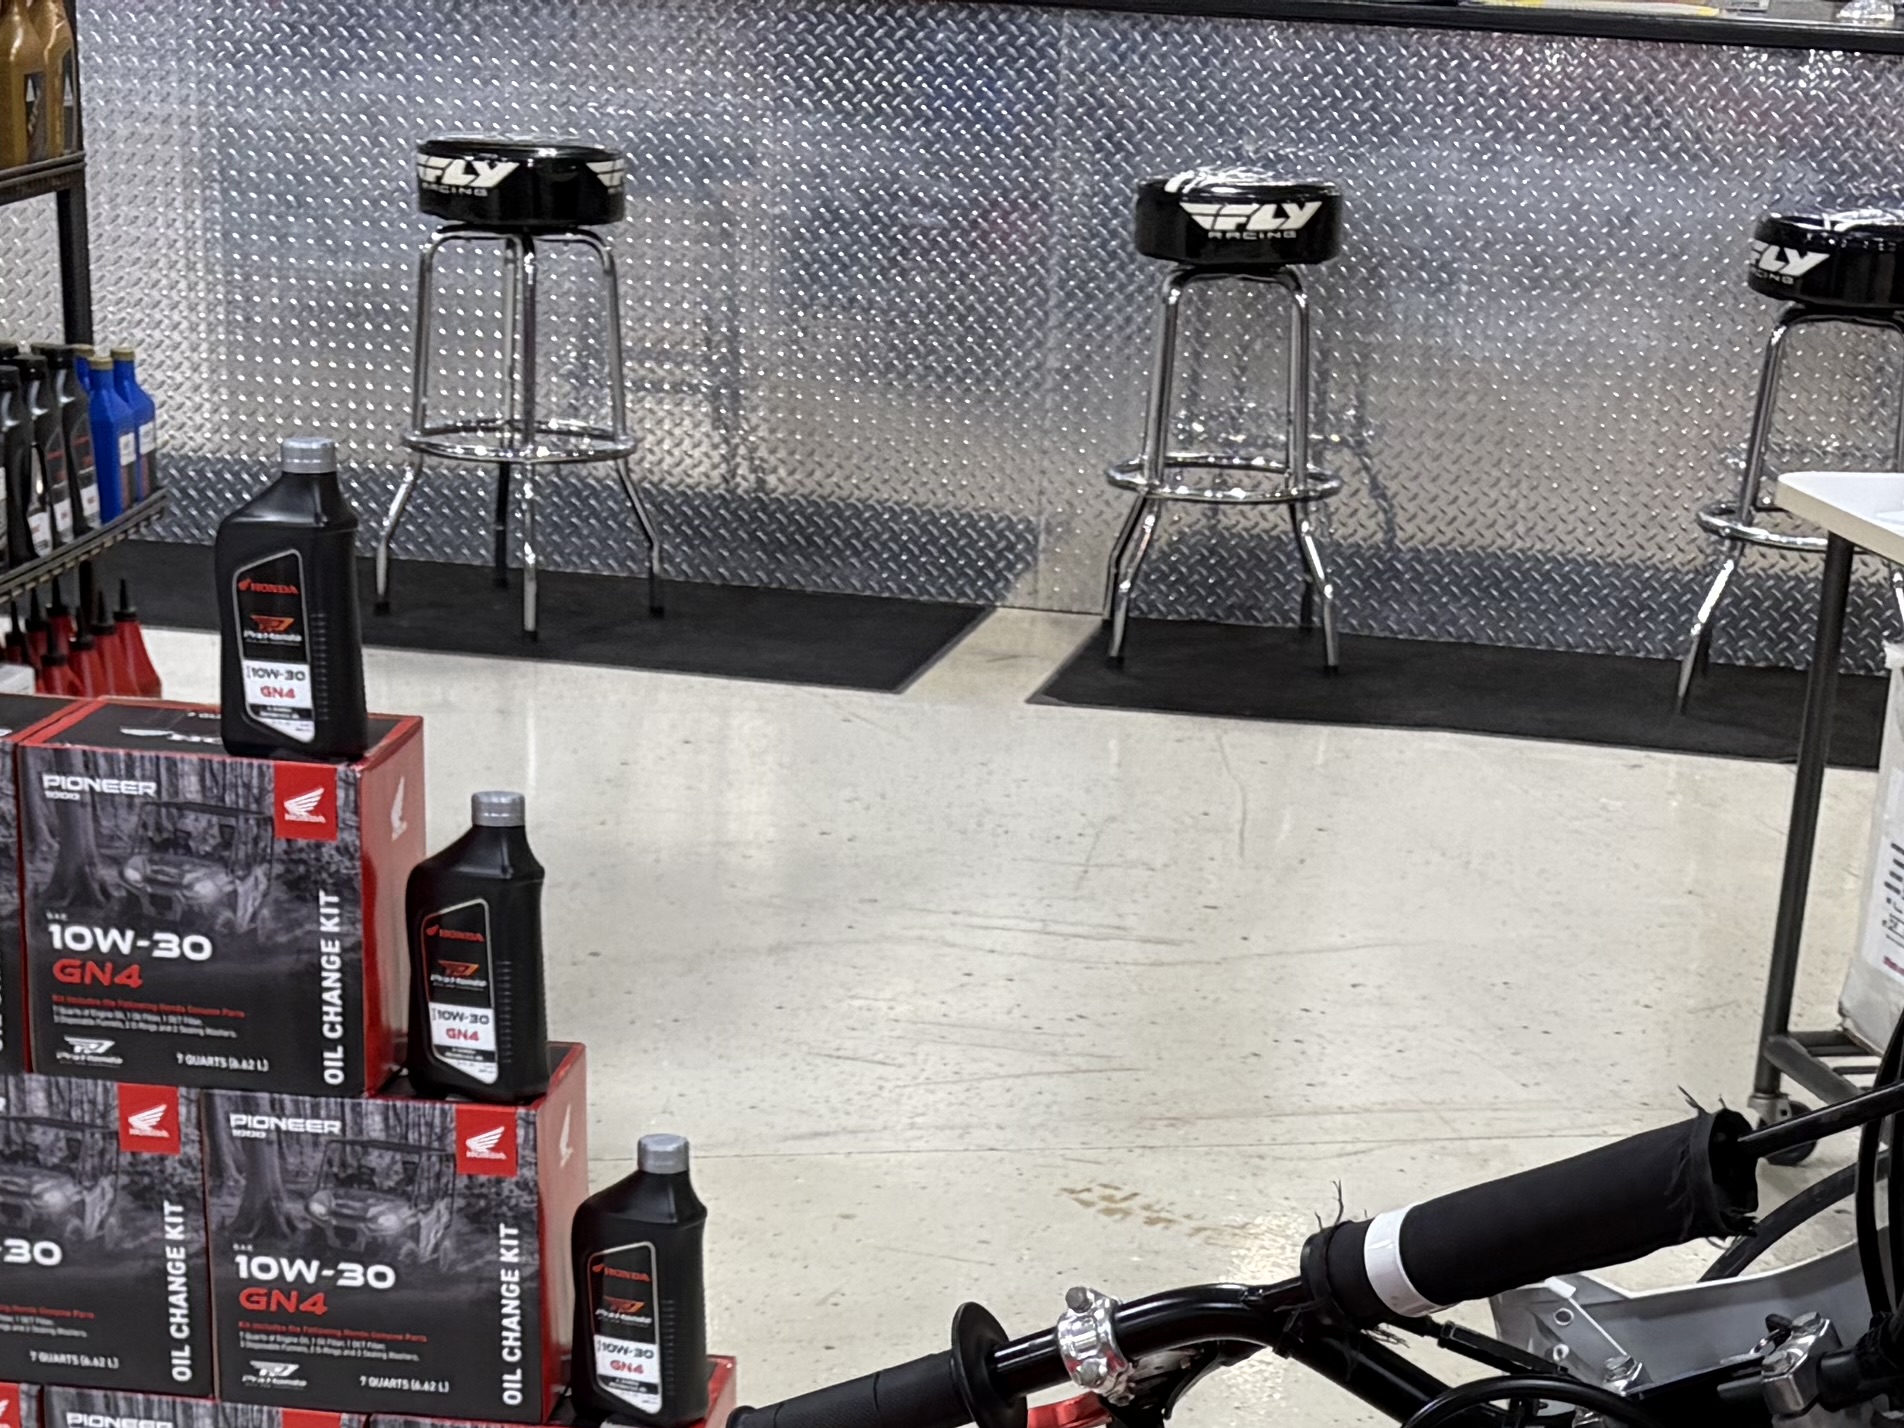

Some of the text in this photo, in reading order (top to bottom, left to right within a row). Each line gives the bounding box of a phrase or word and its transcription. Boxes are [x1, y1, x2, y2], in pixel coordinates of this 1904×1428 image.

[1179, 201, 1323, 231] FLY
[1207, 230, 1297, 240] RACING
[250, 667, 306, 682] 10W-30
[260, 685, 296, 699] GN4
[42, 774, 156, 797] PIONEER
[48, 923, 213, 961] 10W-30
[52, 957, 143, 989] GN4
[319, 889, 346, 1085] OIL CHANGE KIT
[437, 1009, 490, 1025] 10W-30
[446, 1027, 481, 1042] GN4
[229, 1112, 342, 1135] PIONEER
[234, 1254, 396, 1289] 10W-30
[163, 1200, 193, 1382] OIL CHANGE KIT
[239, 1287, 328, 1316] GN4
[499, 1222, 523, 1406] OIL CHANGE KIT
[601, 1342, 655, 1359] 10W-30
[609, 1359, 645, 1375] GN4
[368, 1376, 409, 1391] QUARTS
